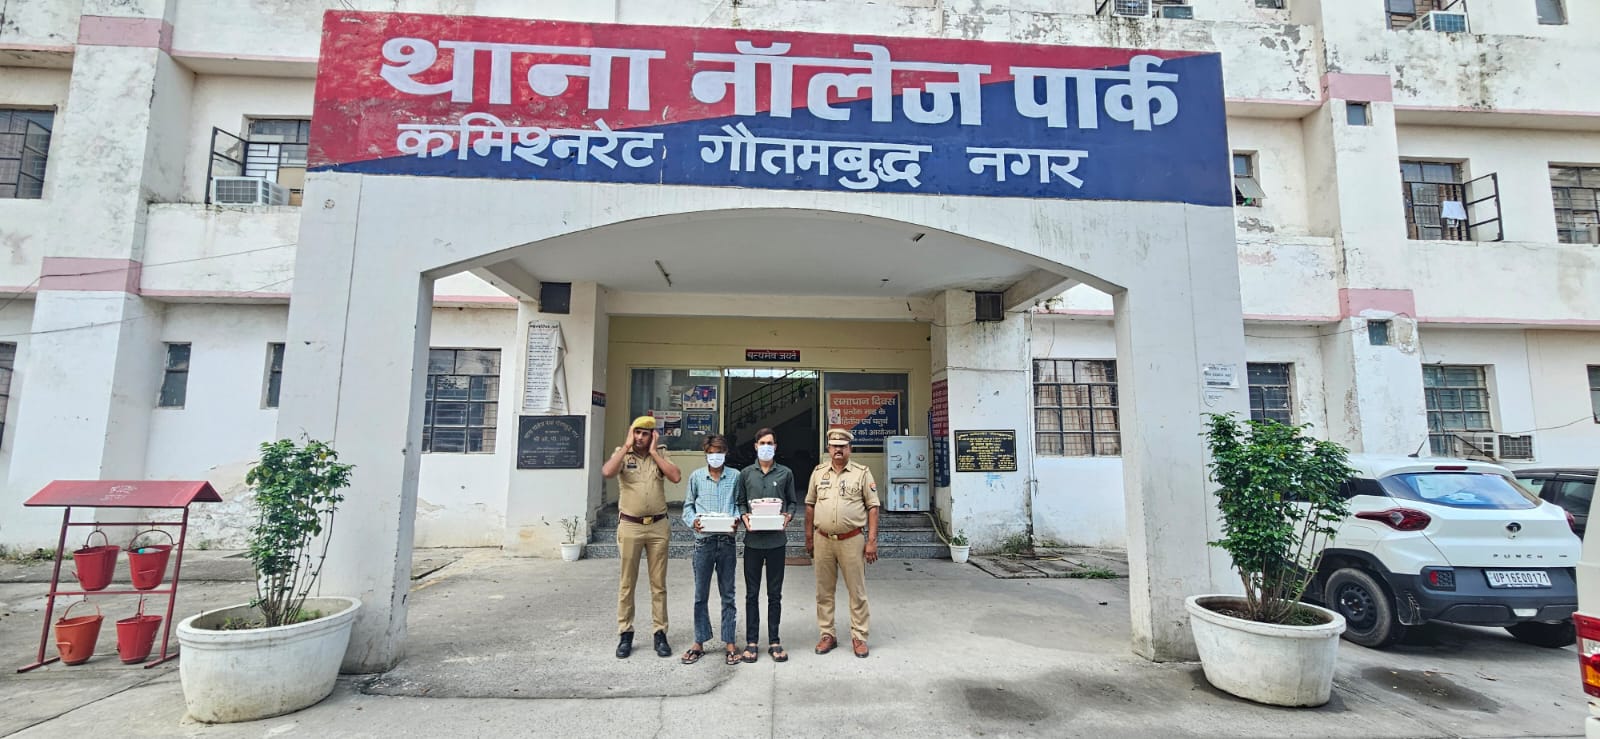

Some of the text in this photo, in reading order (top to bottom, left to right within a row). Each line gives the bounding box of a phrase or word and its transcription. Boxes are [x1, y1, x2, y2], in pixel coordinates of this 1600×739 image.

[380, 37, 1179, 131] थाना नॉलेज पार्क
[396, 112, 1089, 190] कमिश्नरेट गौतमबुद्ध नगर
[833, 395, 896, 406] समाधान दिवस
